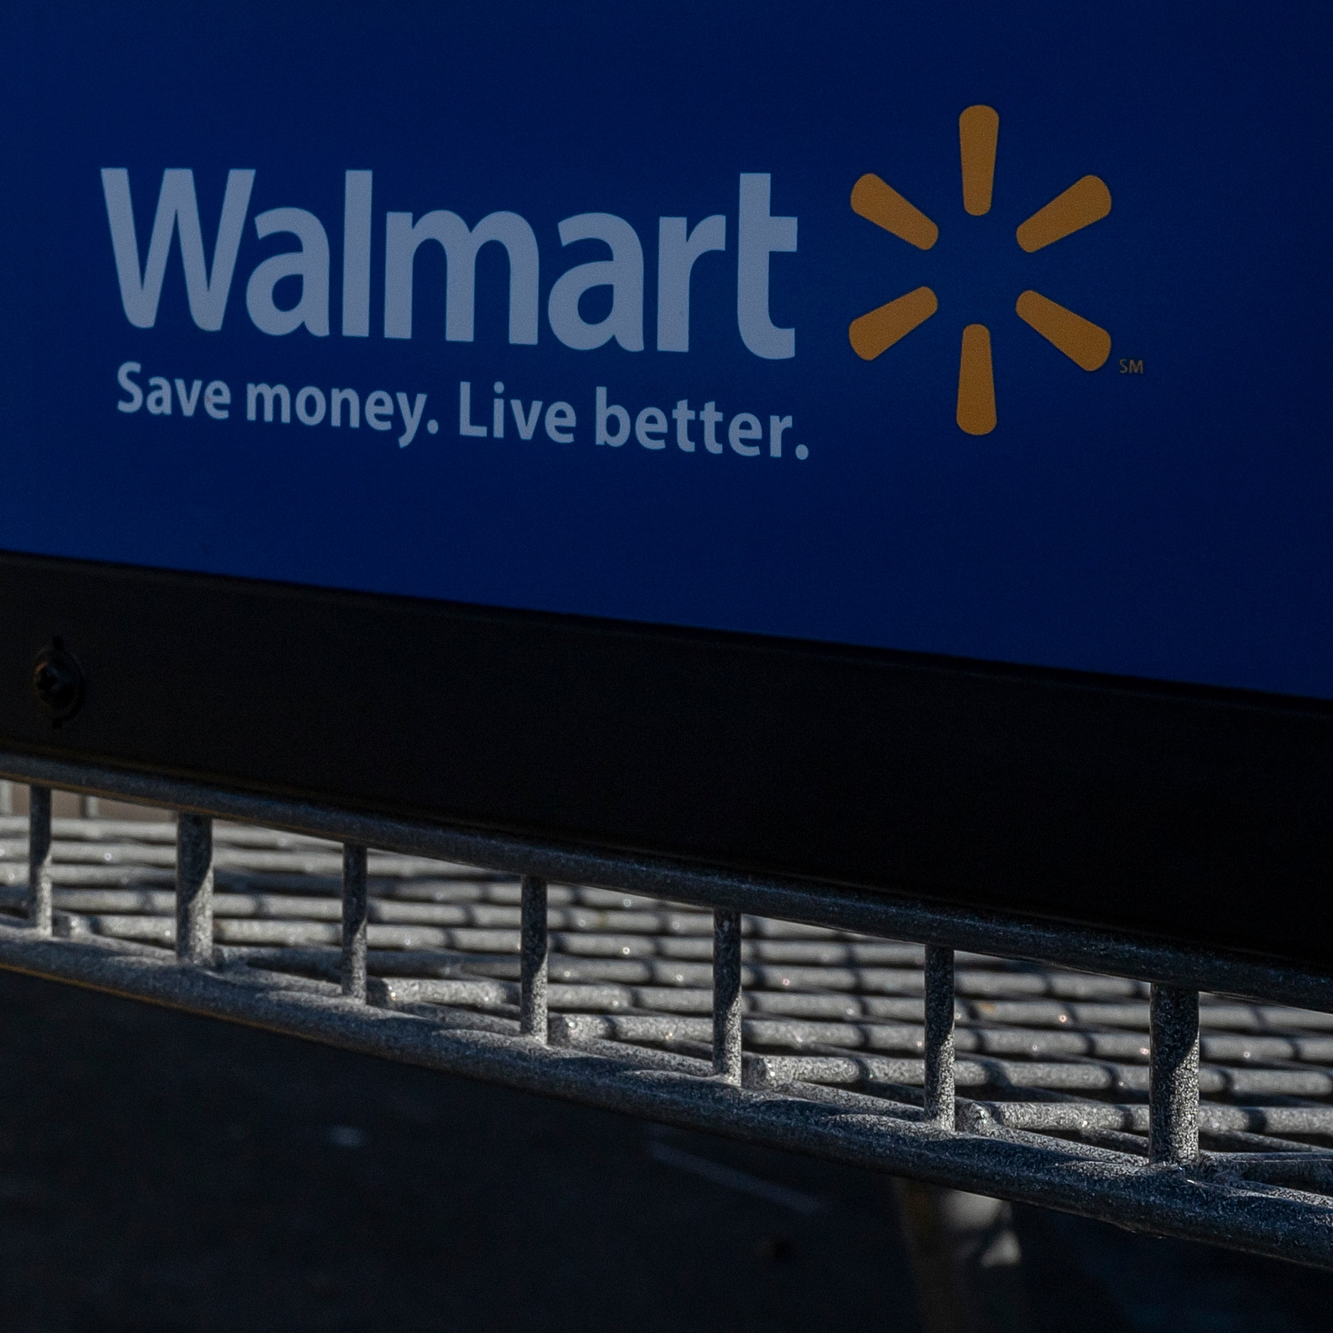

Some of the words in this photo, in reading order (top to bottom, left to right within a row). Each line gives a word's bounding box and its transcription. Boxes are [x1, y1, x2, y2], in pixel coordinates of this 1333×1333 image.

[101, 168, 798, 360] Walmart
[118, 362, 231, 424] Save
[247, 383, 439, 447] money.
[459, 381, 576, 443] Live
[596, 386, 809, 460] better.
[1119, 358, 1144, 374] SM
